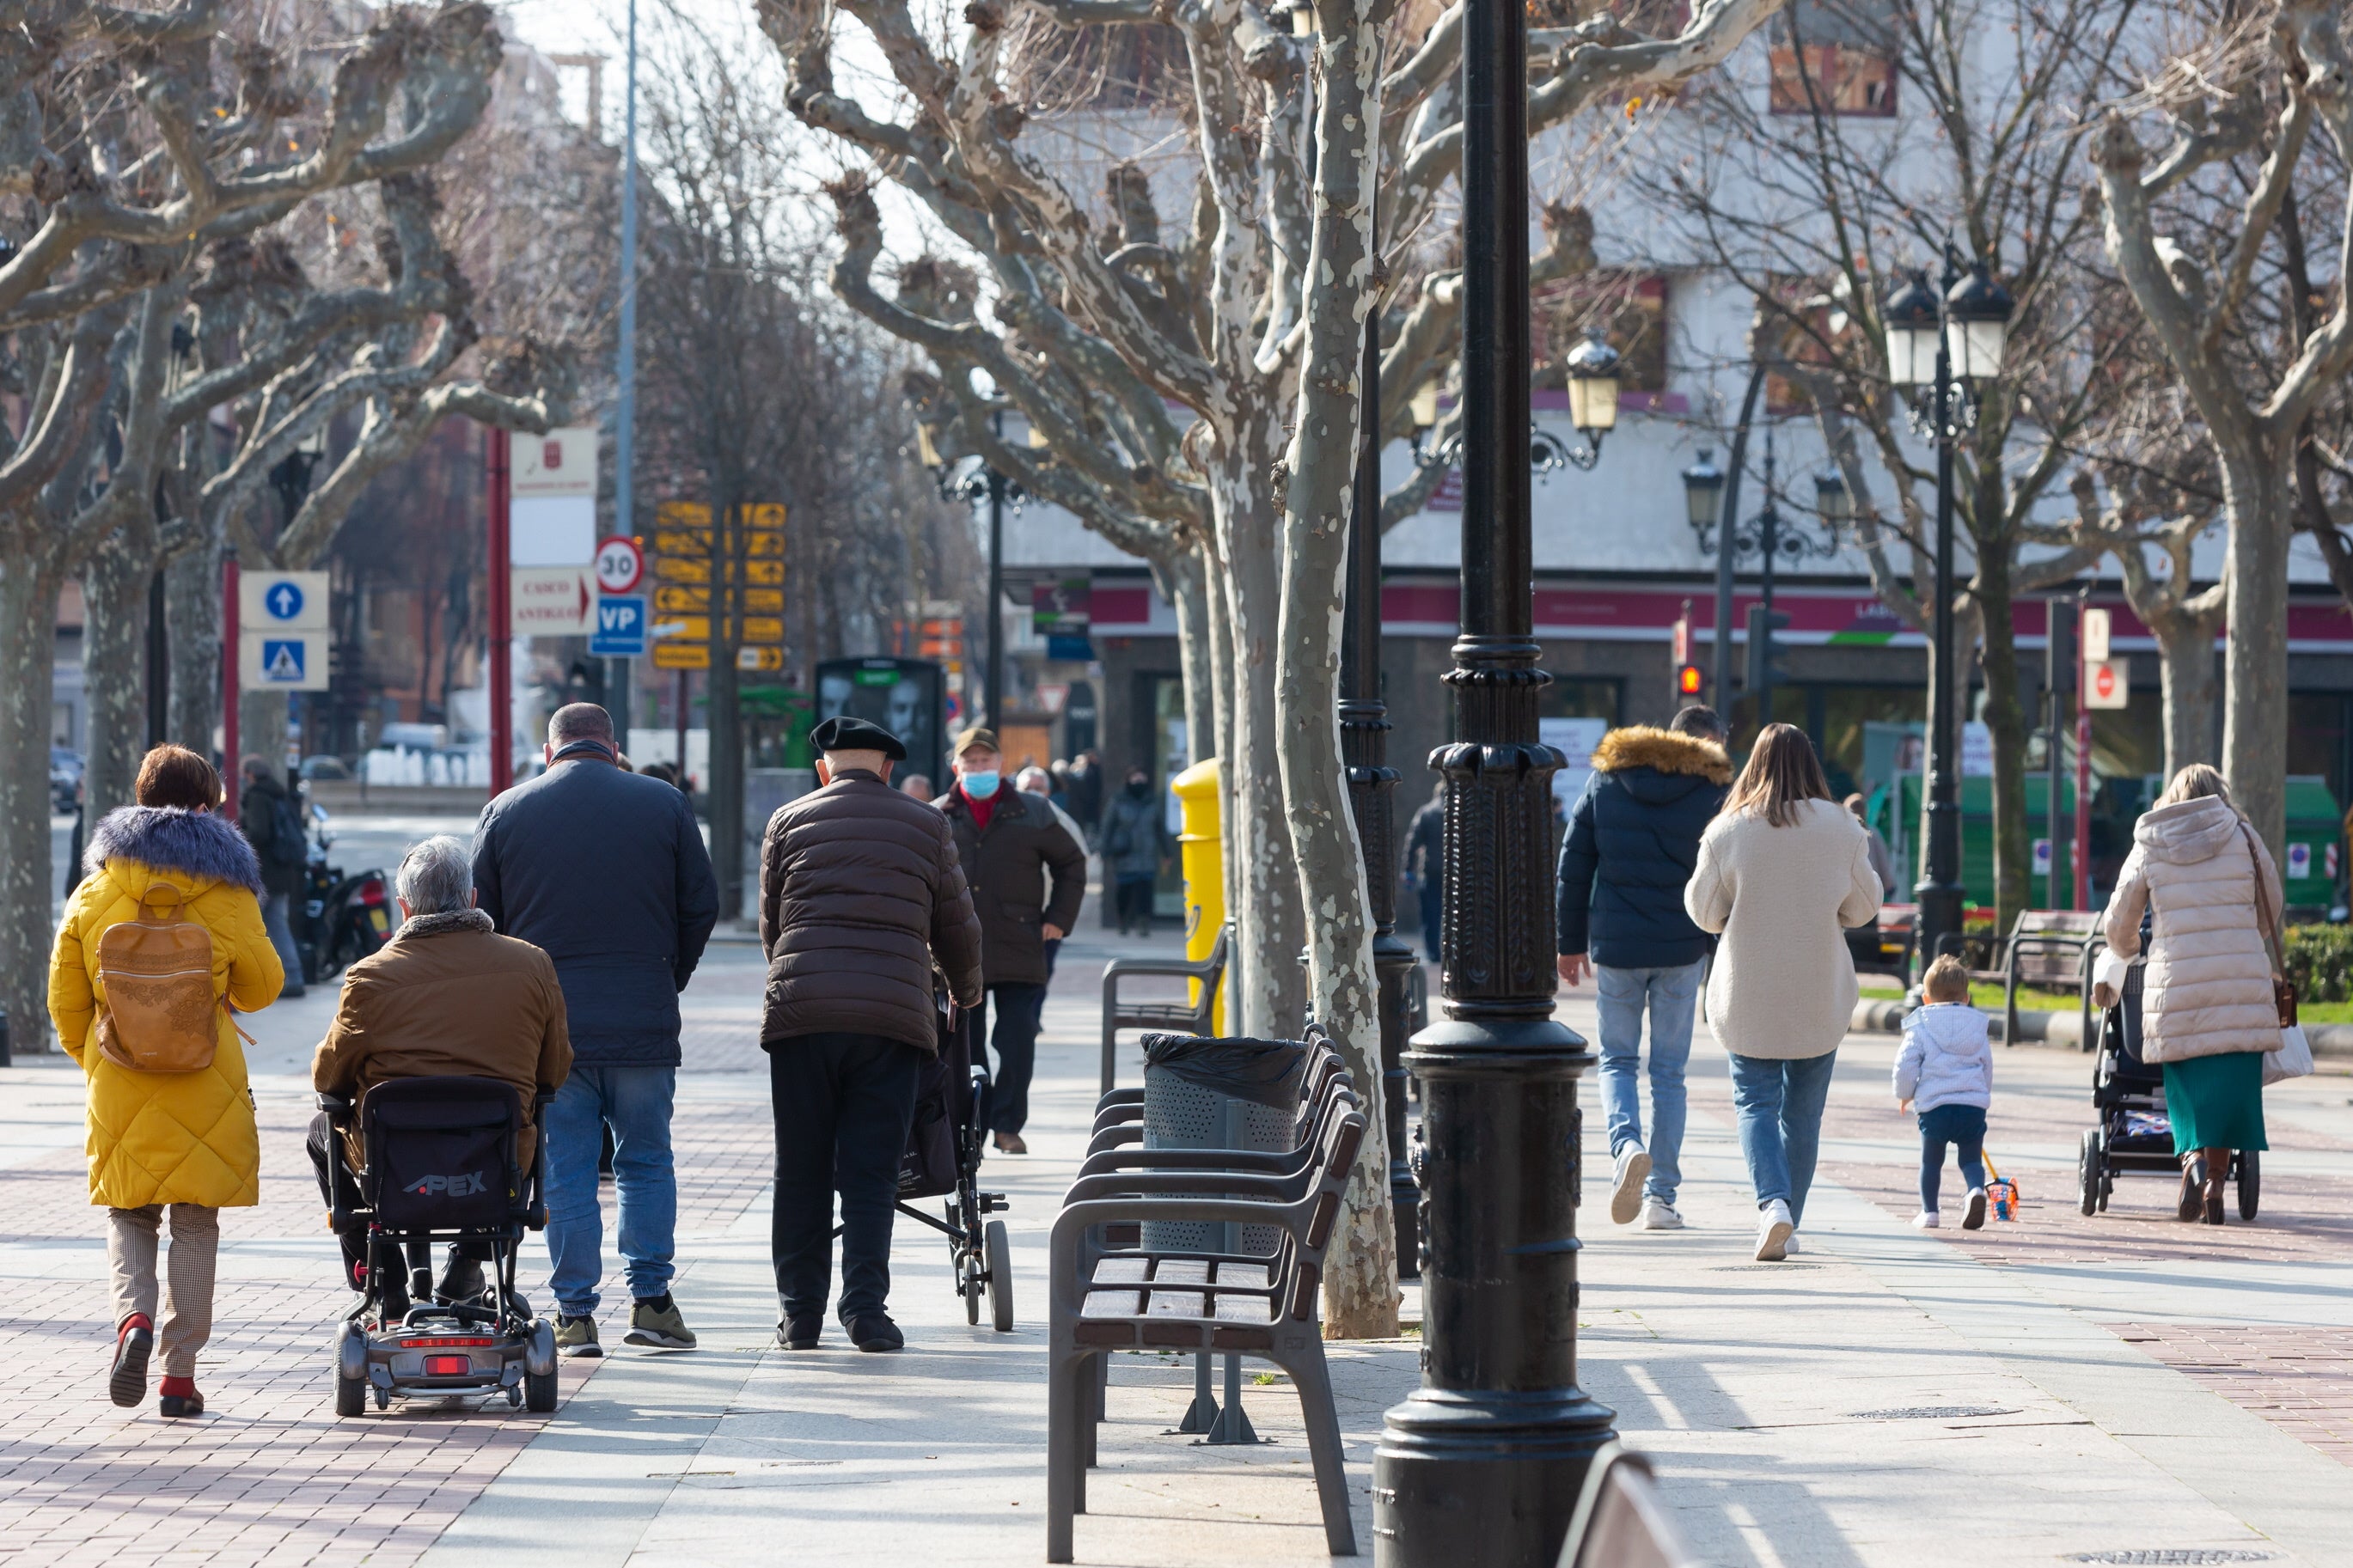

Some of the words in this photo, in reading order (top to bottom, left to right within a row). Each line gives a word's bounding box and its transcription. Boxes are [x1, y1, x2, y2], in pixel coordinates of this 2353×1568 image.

[602, 555, 633, 576] 30
[523, 580, 571, 595] CASCO
[601, 607, 637, 631] VP
[402, 1170, 487, 1197] APEX
